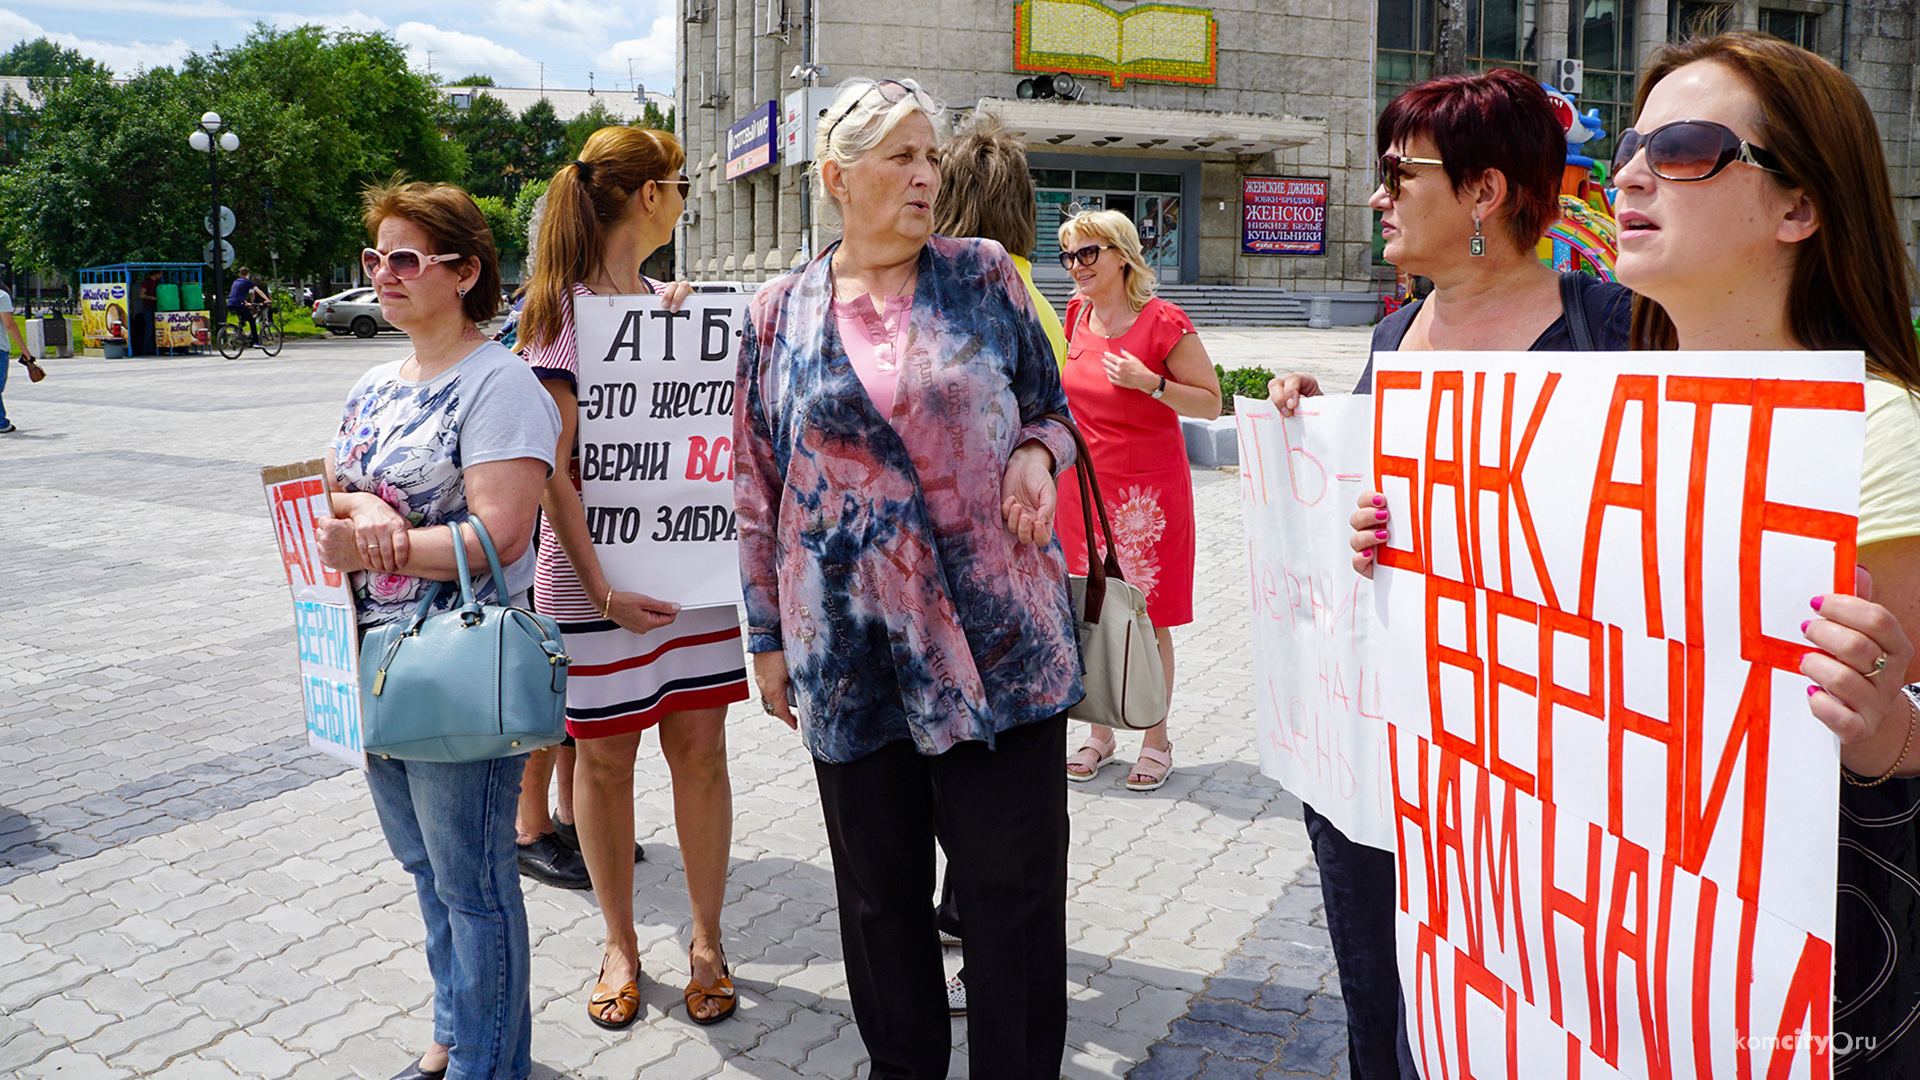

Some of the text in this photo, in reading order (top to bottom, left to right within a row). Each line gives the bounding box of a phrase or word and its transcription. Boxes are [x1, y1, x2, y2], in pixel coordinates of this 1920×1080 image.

[1245, 181, 1325, 196] ЖЕНСКИЕ ДЖИНСЫ
[1245, 205, 1324, 222] ЖЕНСКОЕ
[1247, 222, 1290, 230] НИЖНЕЕ
[1247, 230, 1322, 241] КУПАЛЬНИКИ
[649, 380, 735, 419] ЖЕСТО
[582, 436, 735, 483] ВЕРНИ ВС
[272, 478, 342, 588] АТБ
[586, 505, 641, 545] ЧТО
[1373, 370, 1866, 677] БАНК АТБ
[294, 601, 351, 672] ВЕРНИ
[304, 673, 361, 751] ДЕНЬГИ
[1425, 574, 1772, 898] ВЕРНИ
[1388, 722, 1833, 1080] НАМ НАШИ
